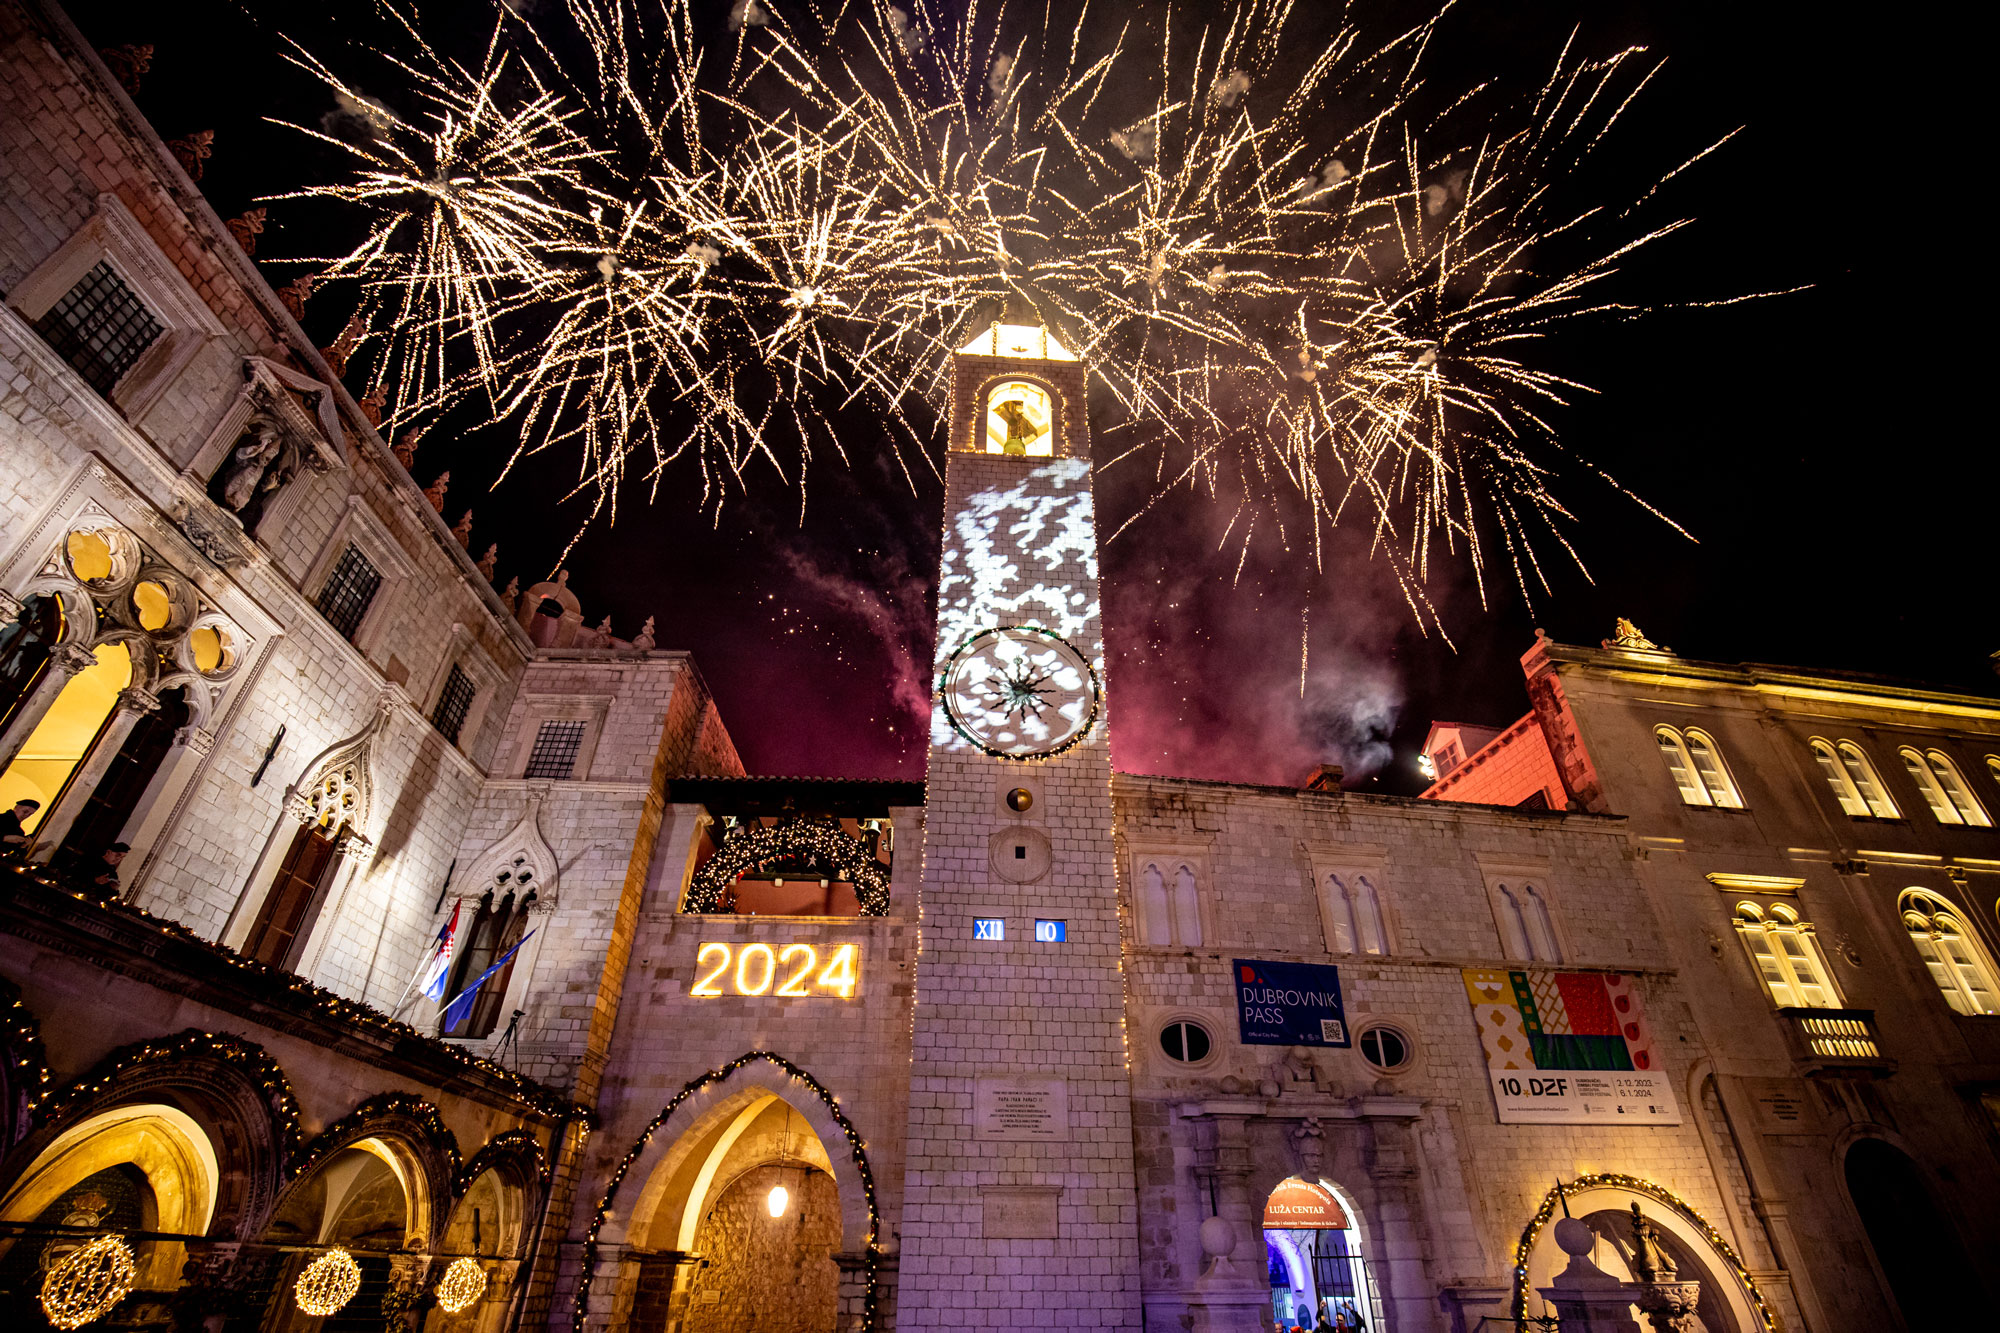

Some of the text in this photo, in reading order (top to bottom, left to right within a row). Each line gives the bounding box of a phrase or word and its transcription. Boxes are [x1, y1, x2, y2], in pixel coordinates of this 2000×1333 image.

[976, 920, 1004, 940] XII
[1044, 922, 1057, 941] 0
[690, 943, 858, 998] 2024
[1243, 987, 1338, 1008] DUBROVNIK
[1245, 1007, 1284, 1024] PASS
[1287, 1182, 1306, 1190] Events
[1269, 1204, 1325, 1214] LUŽA CENTAR
